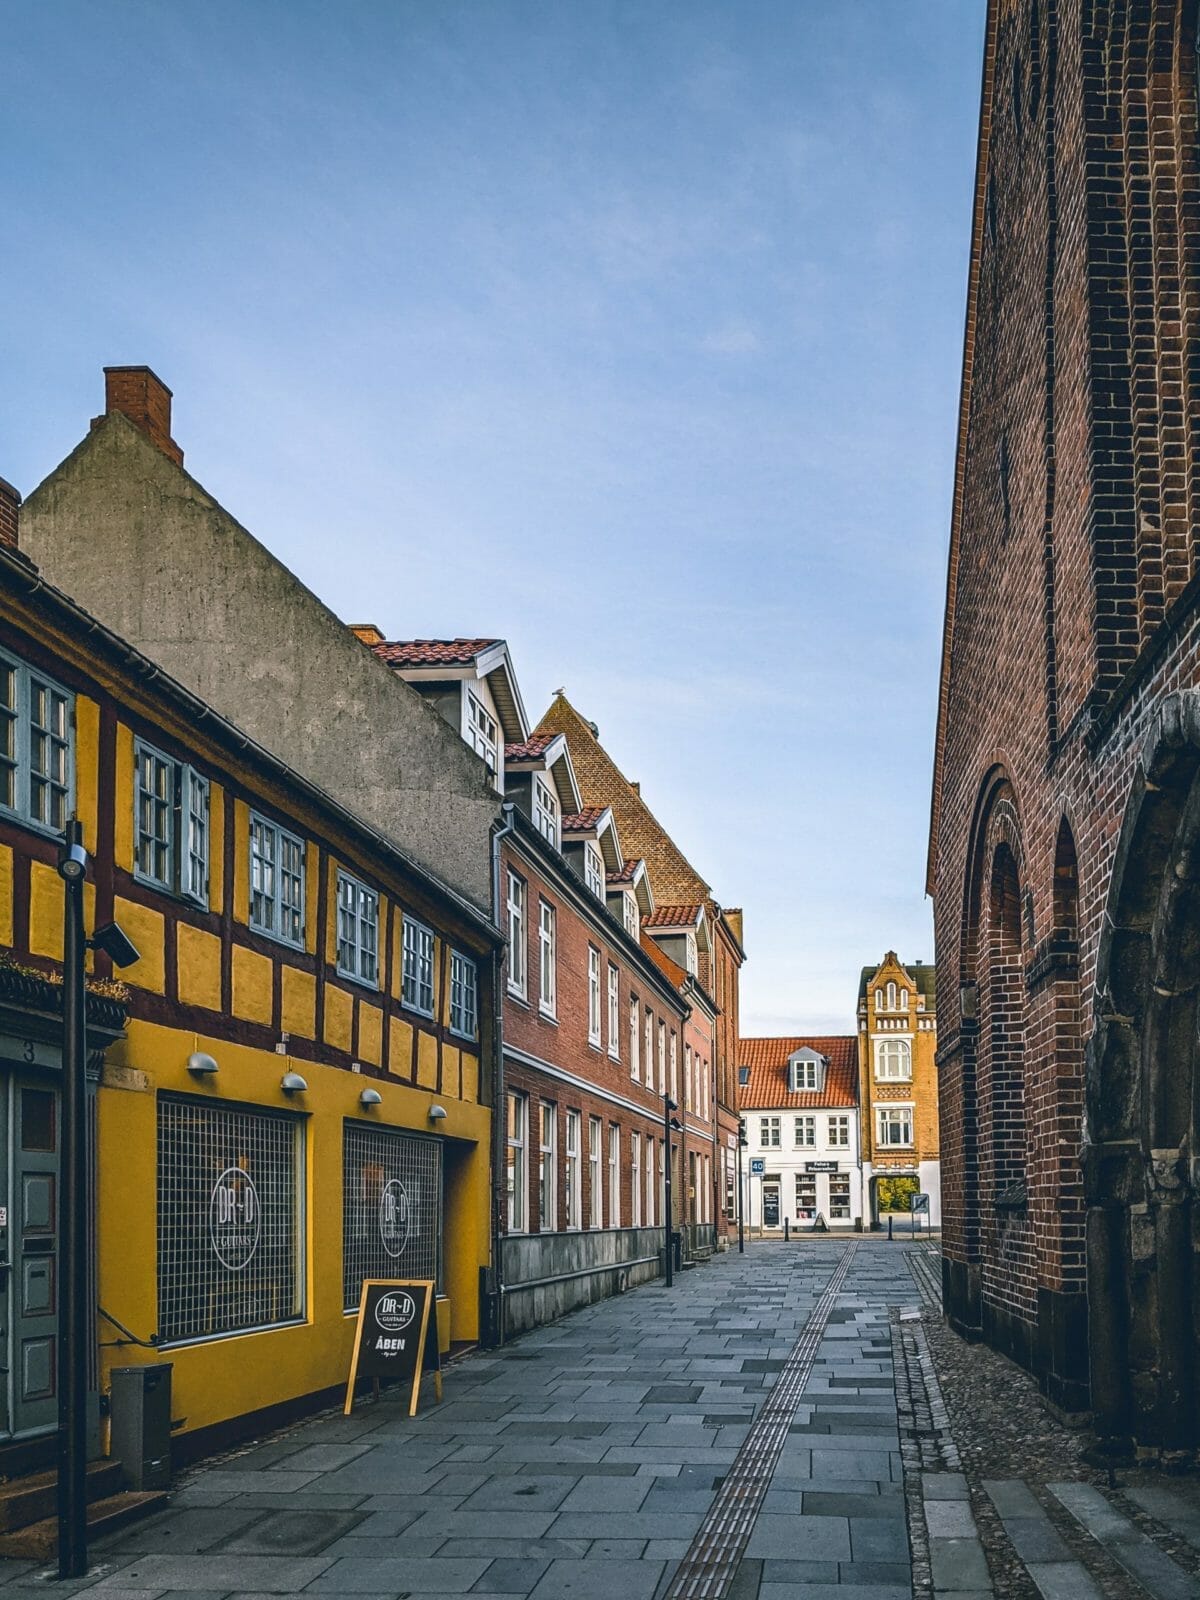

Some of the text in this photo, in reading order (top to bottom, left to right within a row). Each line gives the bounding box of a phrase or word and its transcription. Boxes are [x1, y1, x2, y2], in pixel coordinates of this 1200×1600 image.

[23, 1039, 35, 1063] 3
[752, 1162, 763, 1170] 40
[375, 1335, 406, 1350] ÅBEN
